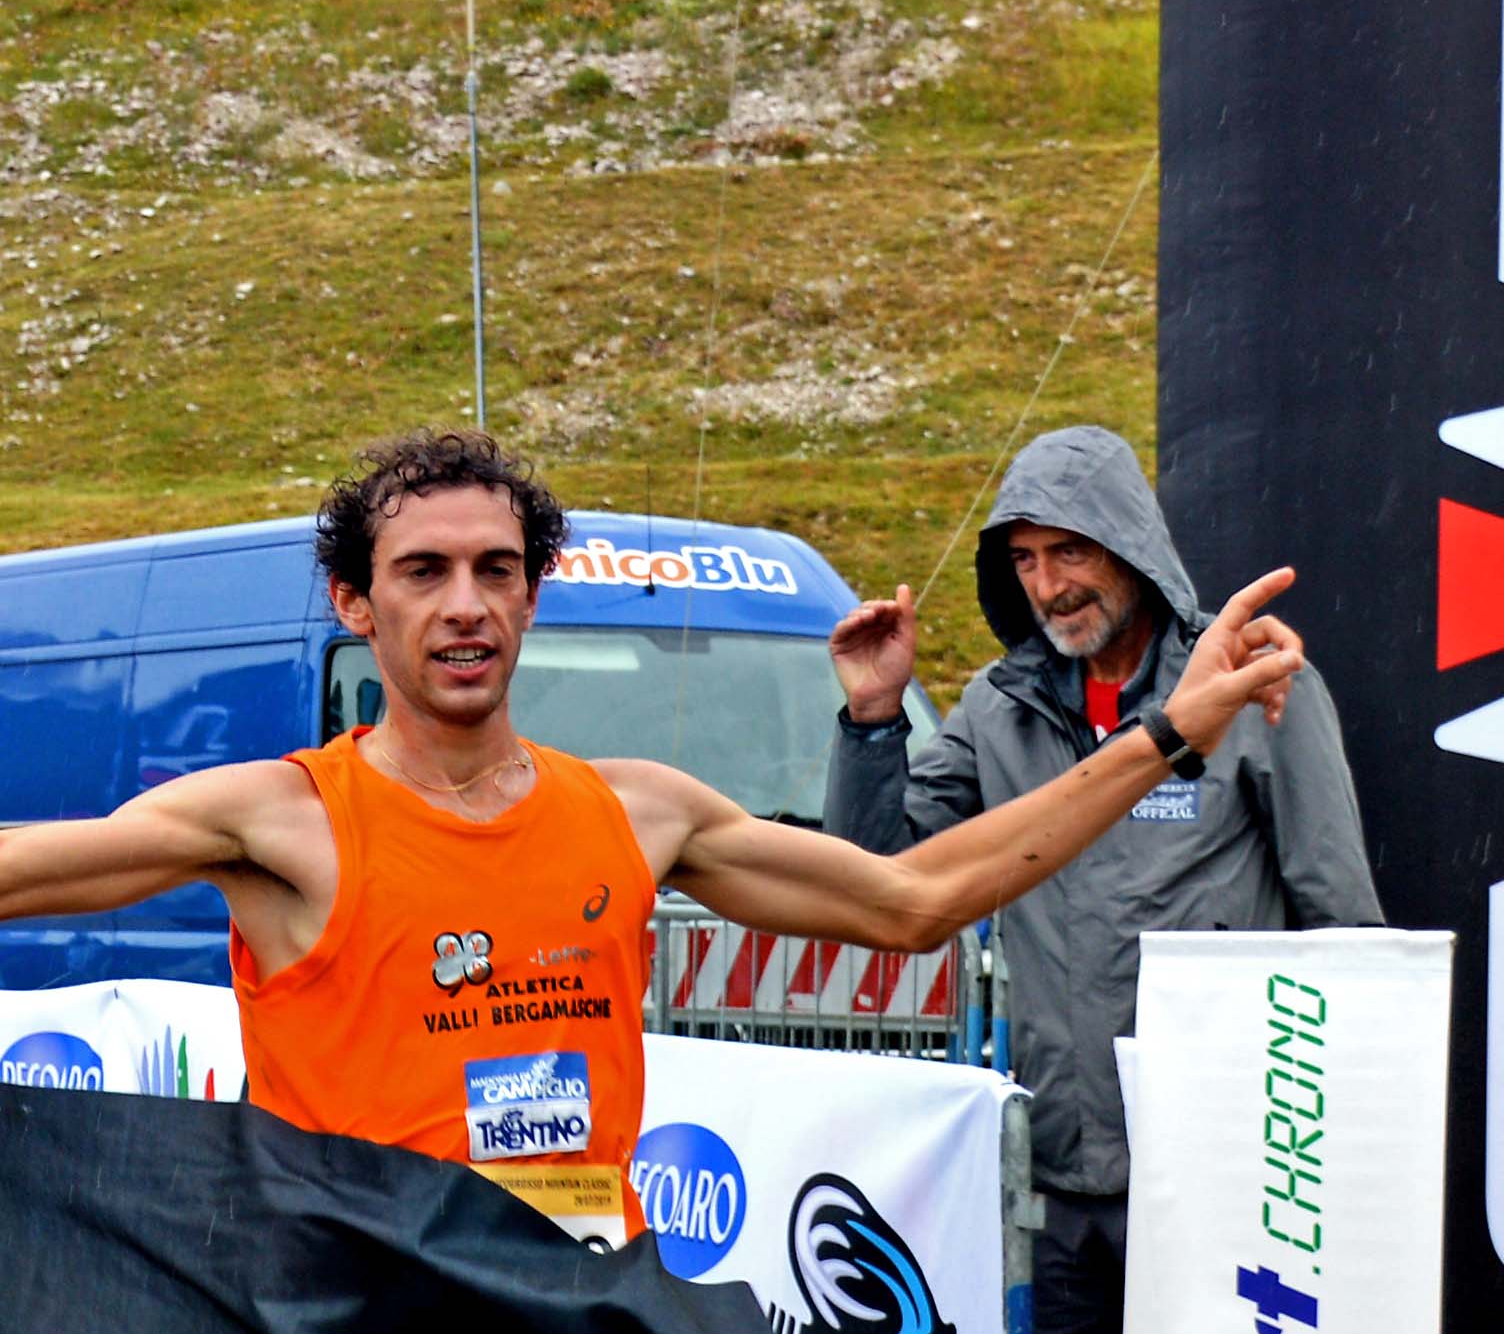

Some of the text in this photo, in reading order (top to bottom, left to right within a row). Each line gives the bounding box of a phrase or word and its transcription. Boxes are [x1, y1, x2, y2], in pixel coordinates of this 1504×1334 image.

[486, 975, 584, 999] ATLETICA
[423, 1008, 479, 1034] VALLI
[476, 1110, 585, 1150] TRENTINO
